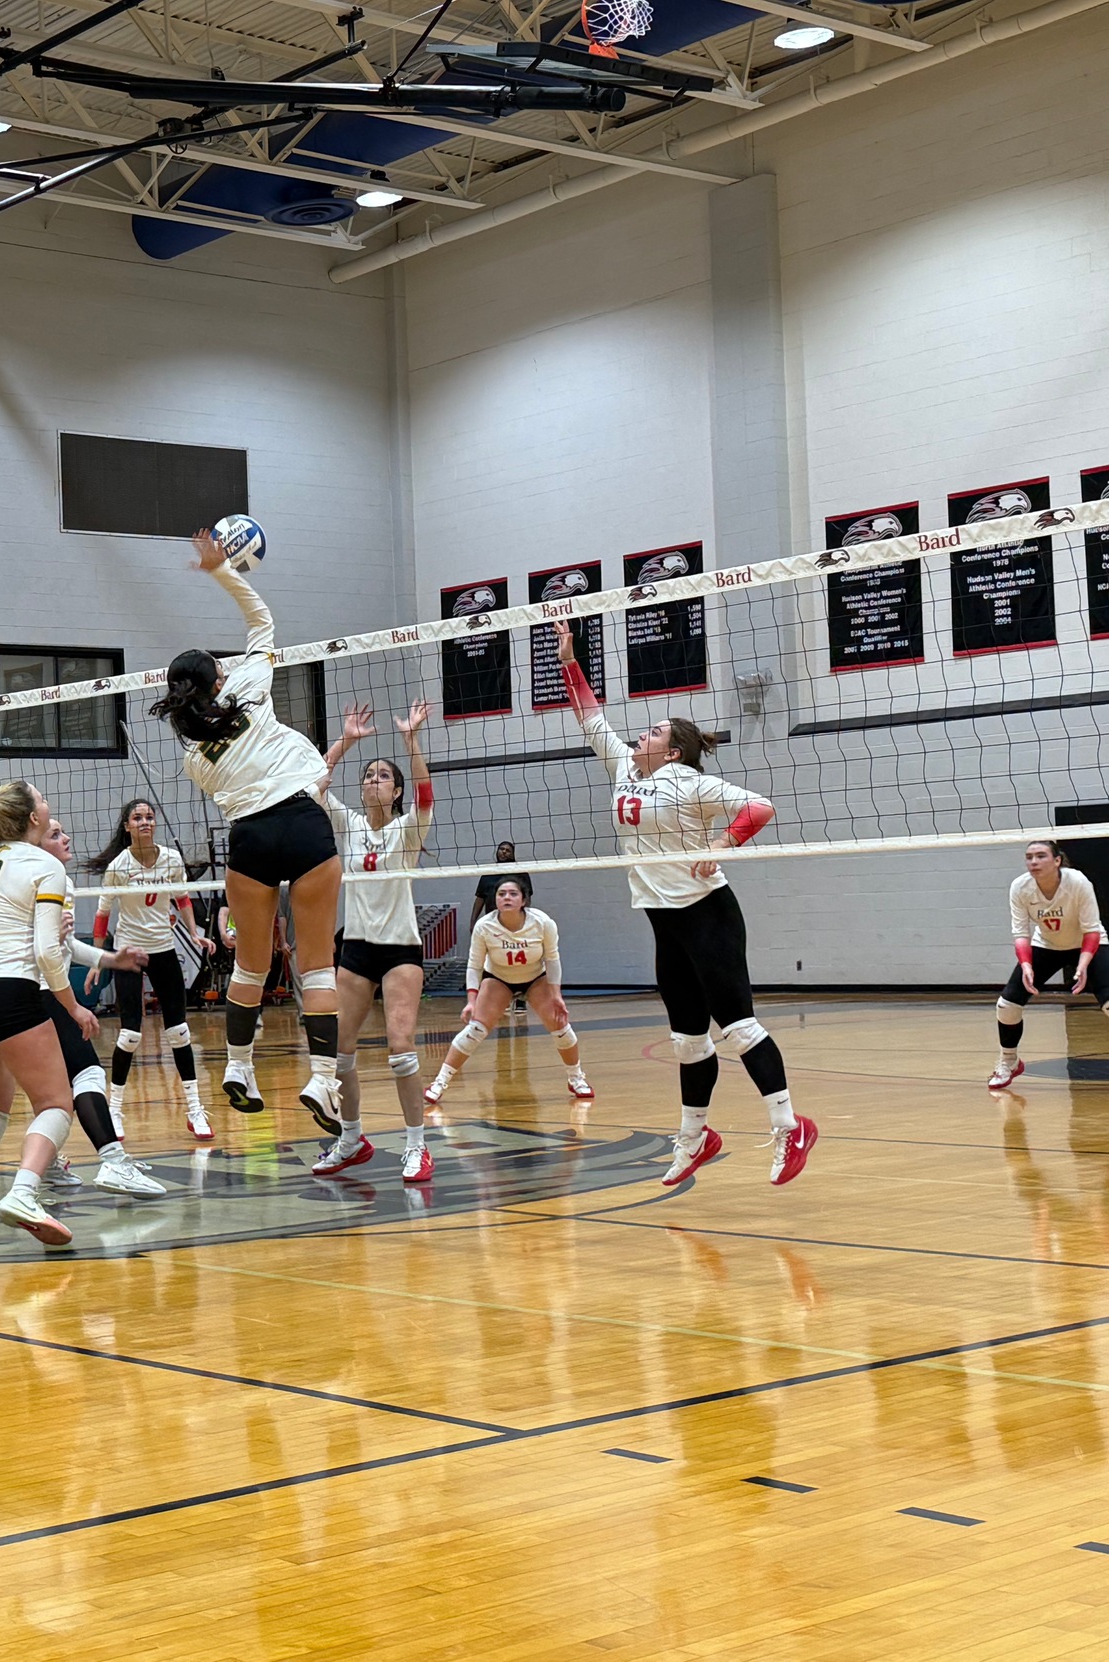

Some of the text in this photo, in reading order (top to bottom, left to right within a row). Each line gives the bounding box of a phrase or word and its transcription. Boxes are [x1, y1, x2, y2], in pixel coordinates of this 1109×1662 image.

[917, 527, 962, 552] Bard
[961, 545, 1039, 562] Conference Champions
[715, 565, 753, 588] Bard
[840, 572, 873, 582] Conference
[874, 568, 905, 577] Champions
[967, 568, 1036, 583] Hudson Valley Men's
[968, 578, 1035, 593] Athletic Conference
[863, 592, 881, 600] Valley
[881, 588, 906, 597] Women's
[869, 597, 902, 606] Conference
[983, 589, 1021, 599] Champions
[541, 598, 574, 619] Bard
[994, 599, 1010, 607] 2001
[994, 608, 1012, 616] 2002
[392, 626, 420, 645] Bard
[144, 669, 166, 685] Bard
[41, 686, 61, 702] Bard
[617, 795, 643, 826] 13
[363, 852, 378, 872] 8
[1037, 905, 1064, 920] Bard
[1043, 918, 1061, 932] 17
[502, 940, 529, 949] Bard
[506, 950, 528, 966] 14
